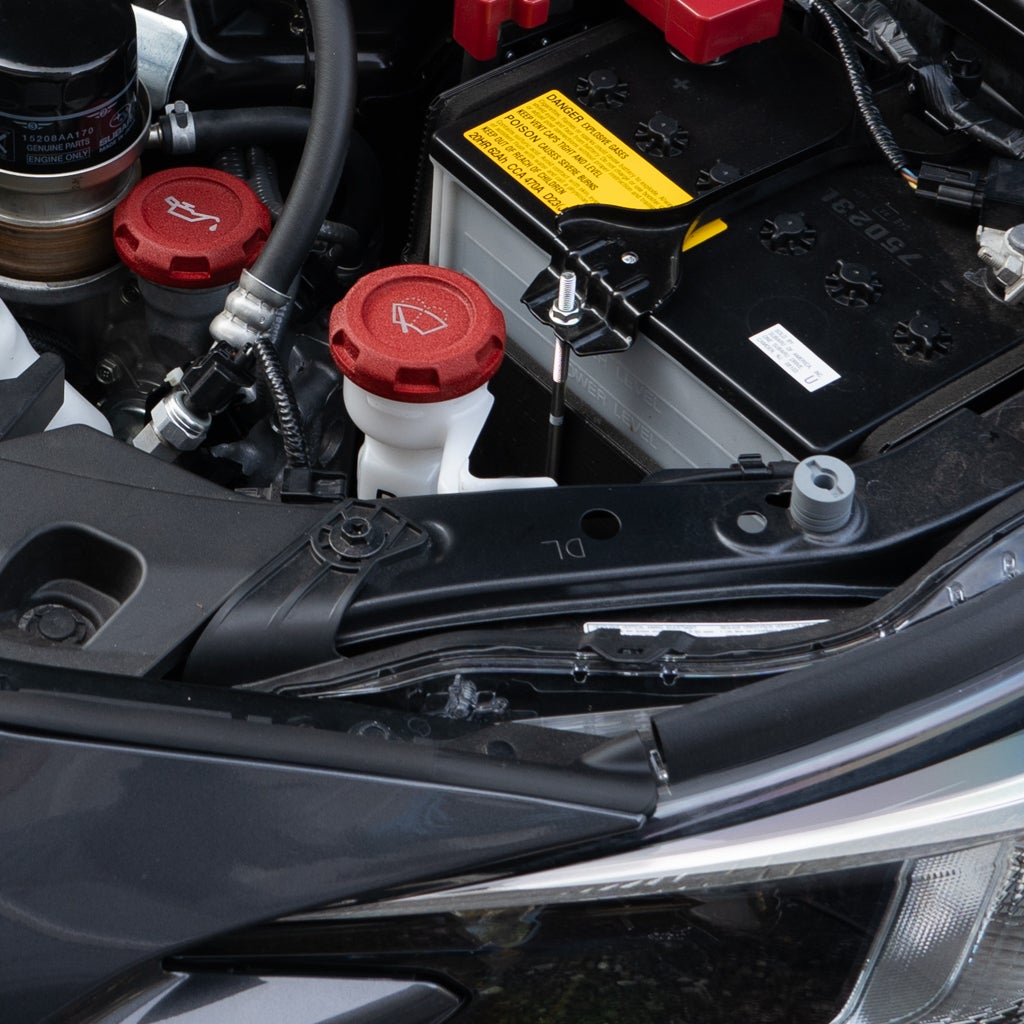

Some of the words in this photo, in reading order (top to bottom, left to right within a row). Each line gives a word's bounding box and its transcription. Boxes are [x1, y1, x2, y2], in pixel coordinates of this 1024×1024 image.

[23, 127, 94, 143] 15208AA170
[26, 143, 64, 152] GENUINE
[65, 137, 90, 151] PARTS
[28, 154, 64, 164] ENGINE
[65, 148, 89, 161] ONLY
[503, 114, 542, 143] POISON
[536, 142, 562, 161] CAUSES
[557, 158, 582, 176] SEVERE
[576, 174, 599, 191] BURNS
[515, 108, 534, 121] KEEP
[529, 119, 547, 132] VENT
[542, 130, 562, 143] CAPS
[556, 141, 577, 156] TIGHT
[572, 153, 589, 165] AND
[583, 163, 605, 178] LEVEL
[545, 93, 586, 123] DANGER
[580, 122, 612, 145] EXPLOSIVE
[607, 143, 630, 160] GASES
[468, 131, 493, 149] 20HR
[486, 146, 510, 164] 62Ah
[506, 162, 529, 179] CCA
[522, 176, 547, 193] 470A
[480, 126, 499, 139] KEEP
[493, 136, 510, 147] OUT
[504, 145, 518, 154] OF
[512, 151, 535, 168] REACH
[529, 165, 542, 174] OF
[537, 172, 568, 195] CHILDREN
[802, 375, 819, 385] U
